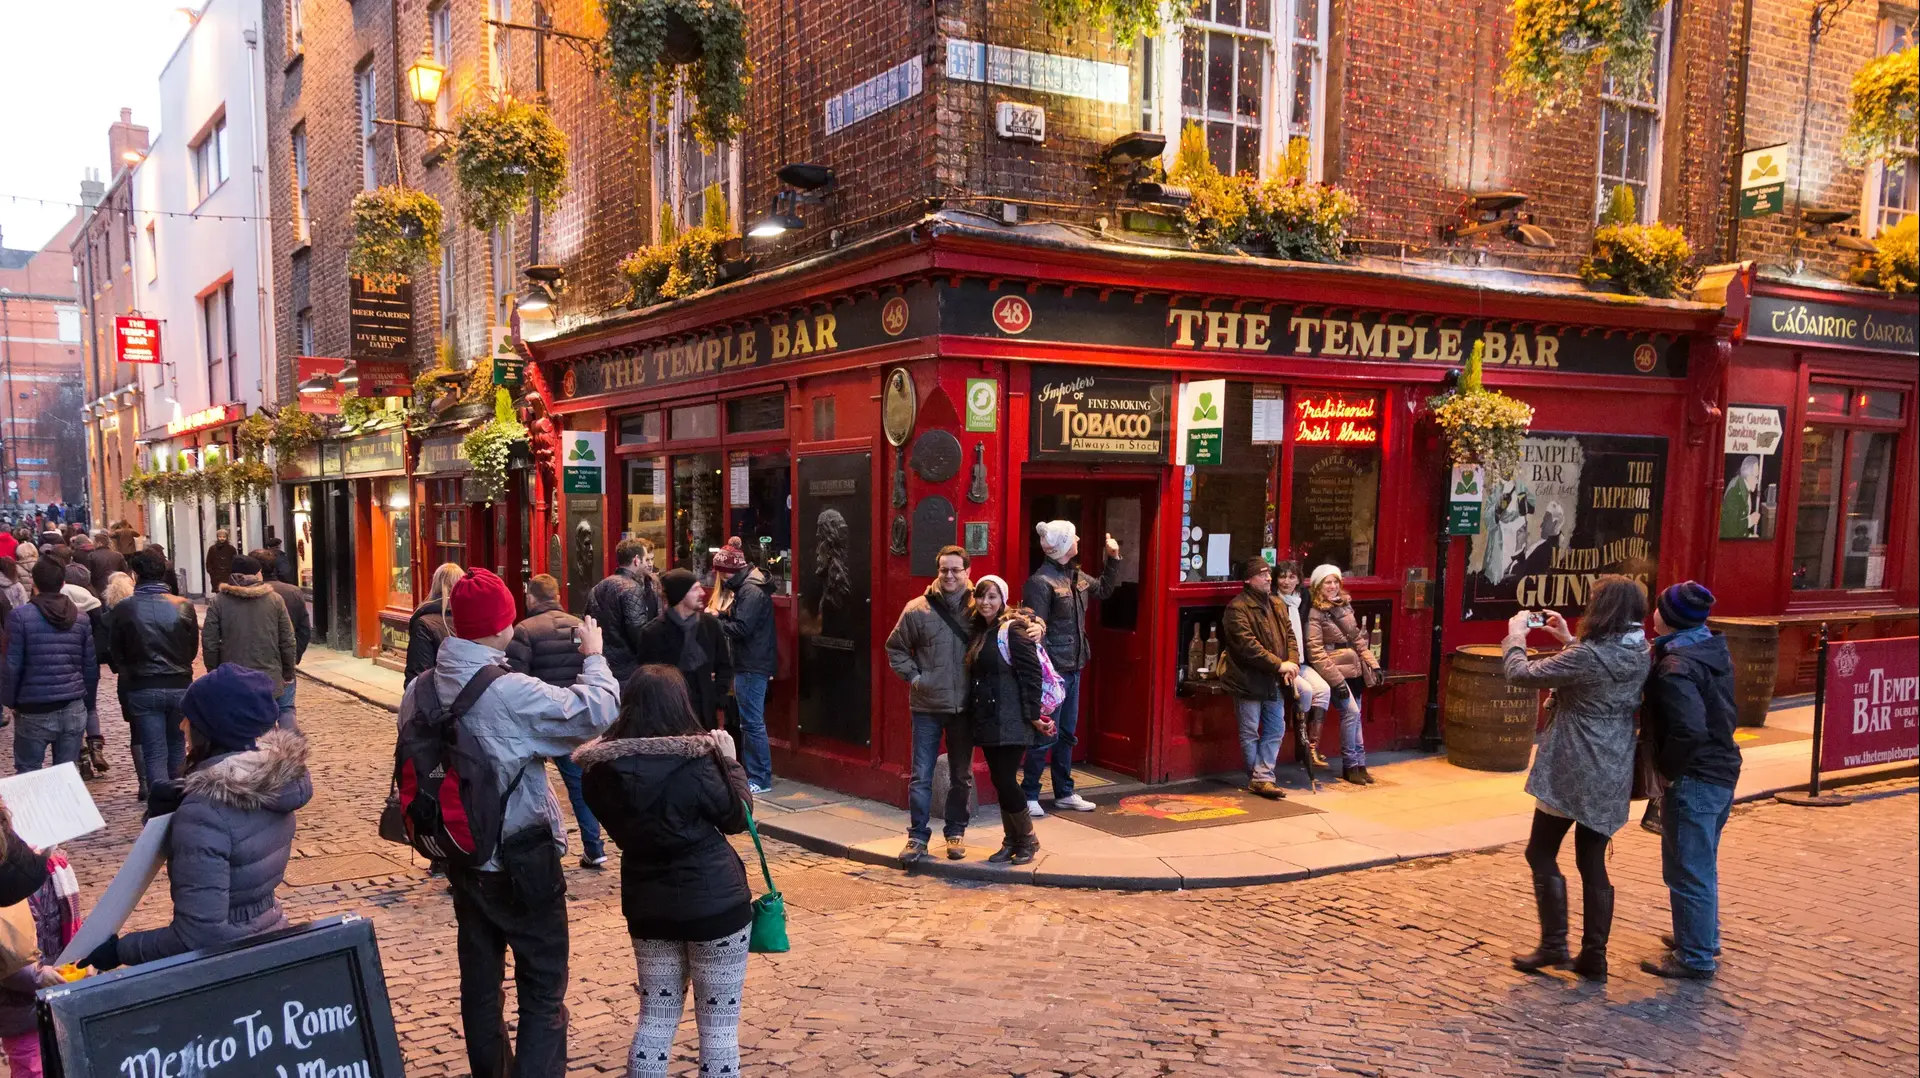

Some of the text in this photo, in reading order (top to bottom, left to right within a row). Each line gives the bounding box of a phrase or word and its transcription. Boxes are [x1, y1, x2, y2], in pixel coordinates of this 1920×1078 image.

[363, 277, 397, 295] BAR
[352, 309, 410, 319] BEER GARDEN
[886, 305, 903, 330] 48
[999, 301, 1024, 324] 48
[128, 319, 146, 328] THE
[356, 333, 406, 343] LIVE MUSIC
[369, 341, 395, 349] DAILY
[1168, 308, 1560, 368] THE TEMPLE BAR
[601, 313, 838, 390] THE TEMPLE BAR
[1637, 347, 1651, 368] 48
[1038, 376, 1095, 404] Importers
[1074, 392, 1084, 400] OF
[1088, 398, 1151, 411] FINE SMOKING
[1298, 398, 1375, 419] Traditional
[1053, 403, 1151, 445] TOBACCO
[1729, 411, 1744, 424] Beer
[1747, 412, 1771, 426] Garden
[1295, 420, 1331, 441] Irish
[1336, 421, 1377, 441] Music
[1728, 425, 1757, 440] Smoking
[431, 445, 448, 461] THE
[1073, 439, 1158, 451] Always in Stock
[1732, 439, 1749, 452] Area
[1310, 456, 1345, 475] TEMPLE
[1532, 464, 1563, 484] BAR
[1627, 461, 1653, 484] THE
[1592, 486, 1651, 509] EMPEROR
[1634, 513, 1649, 534] OF
[1550, 537, 1651, 571] MALTED LIQUORS
[1853, 682, 1869, 695] THE
[1504, 714, 1528, 723] BAR
[1852, 697, 1892, 735] BAR
[1904, 717, 1916, 728] Est.
[233, 1009, 274, 1058] To
[283, 1000, 357, 1050] Rome
